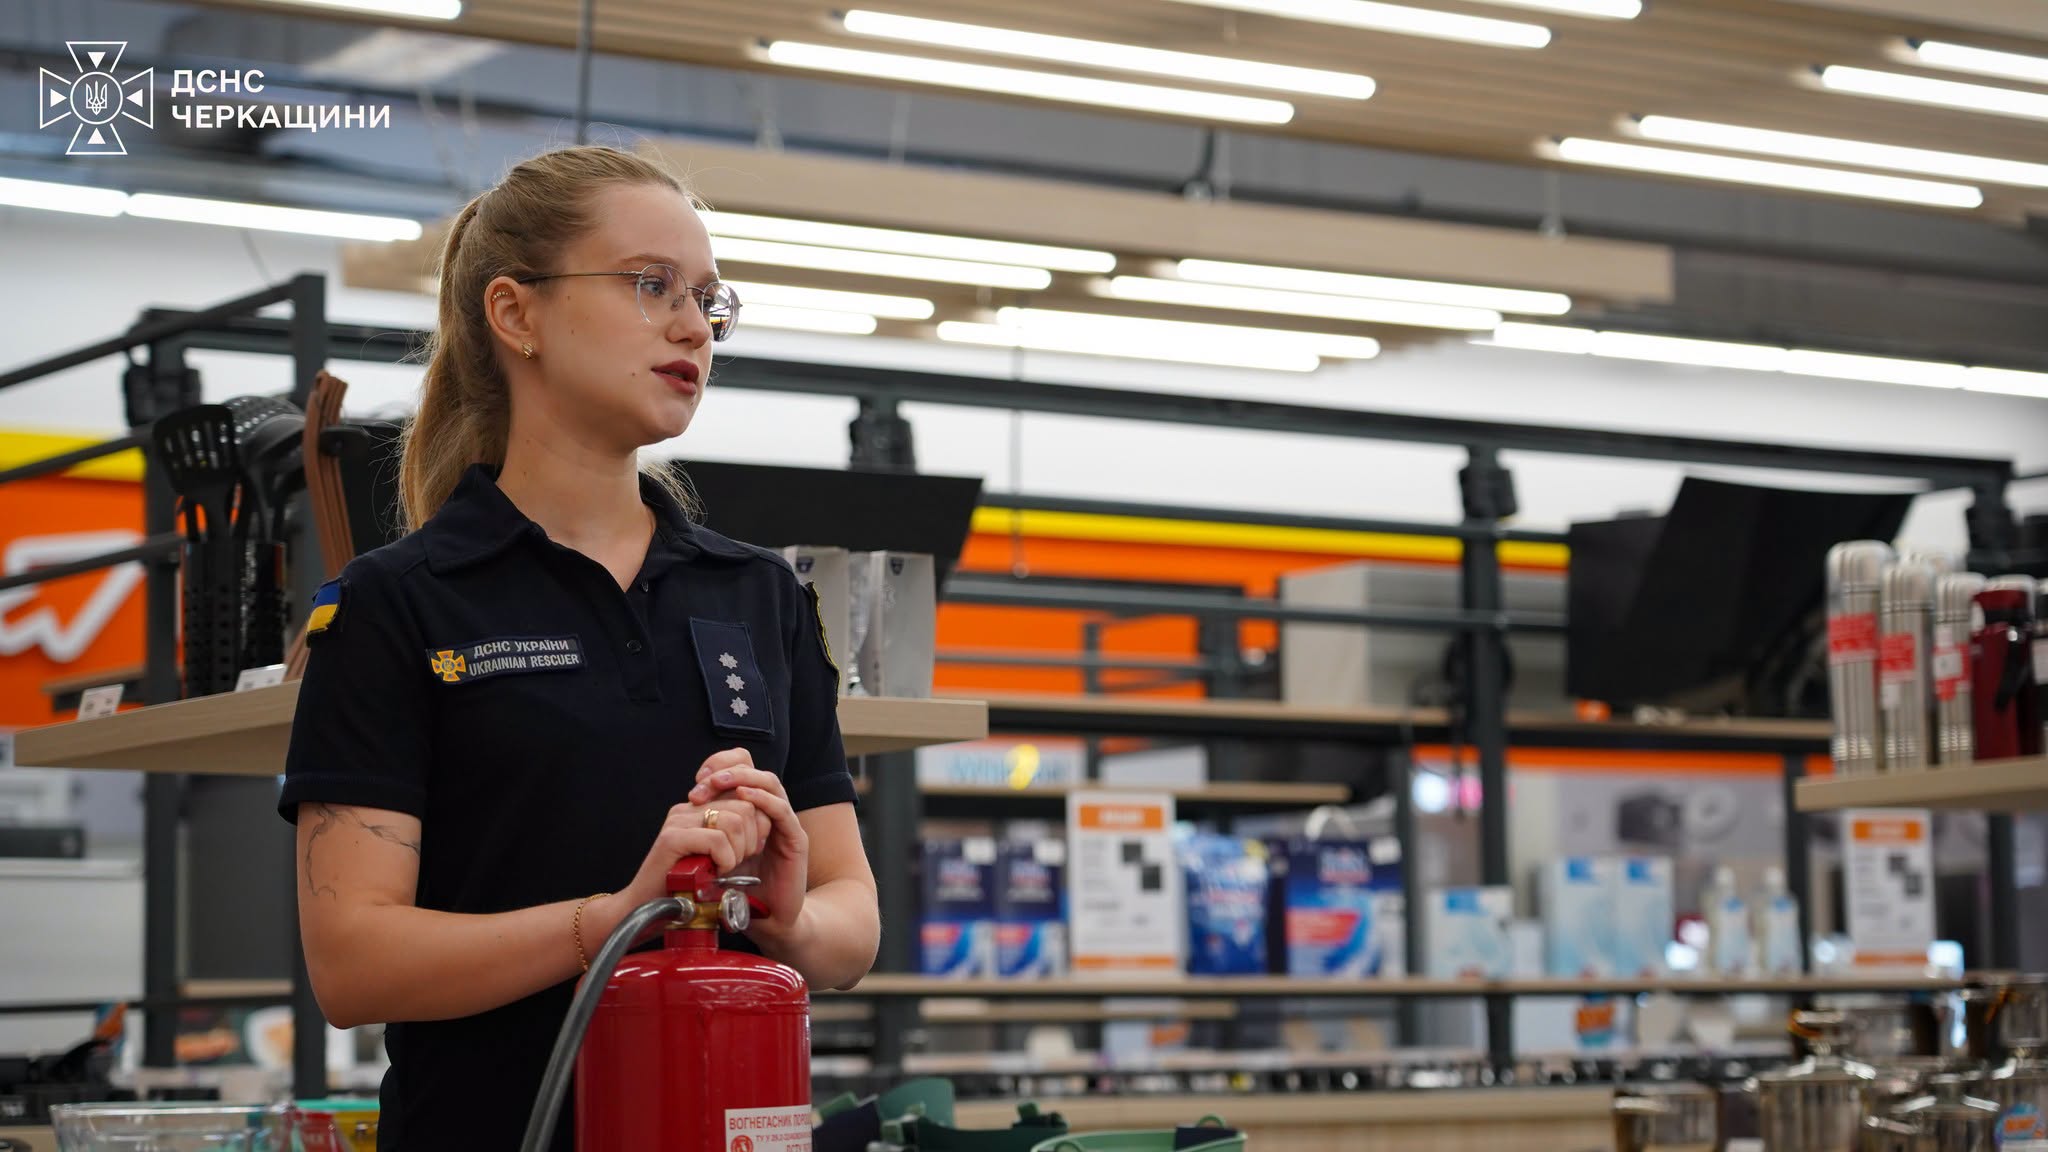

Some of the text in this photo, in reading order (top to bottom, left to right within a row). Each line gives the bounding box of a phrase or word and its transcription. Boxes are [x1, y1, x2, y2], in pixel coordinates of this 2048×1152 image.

[473, 639, 569, 658] ДСНС УКРАЇНИ
[468, 654, 580, 676] UKRAINIAN RESCUER
[729, 1115, 792, 1130] ВОГНЕГАСНИК
